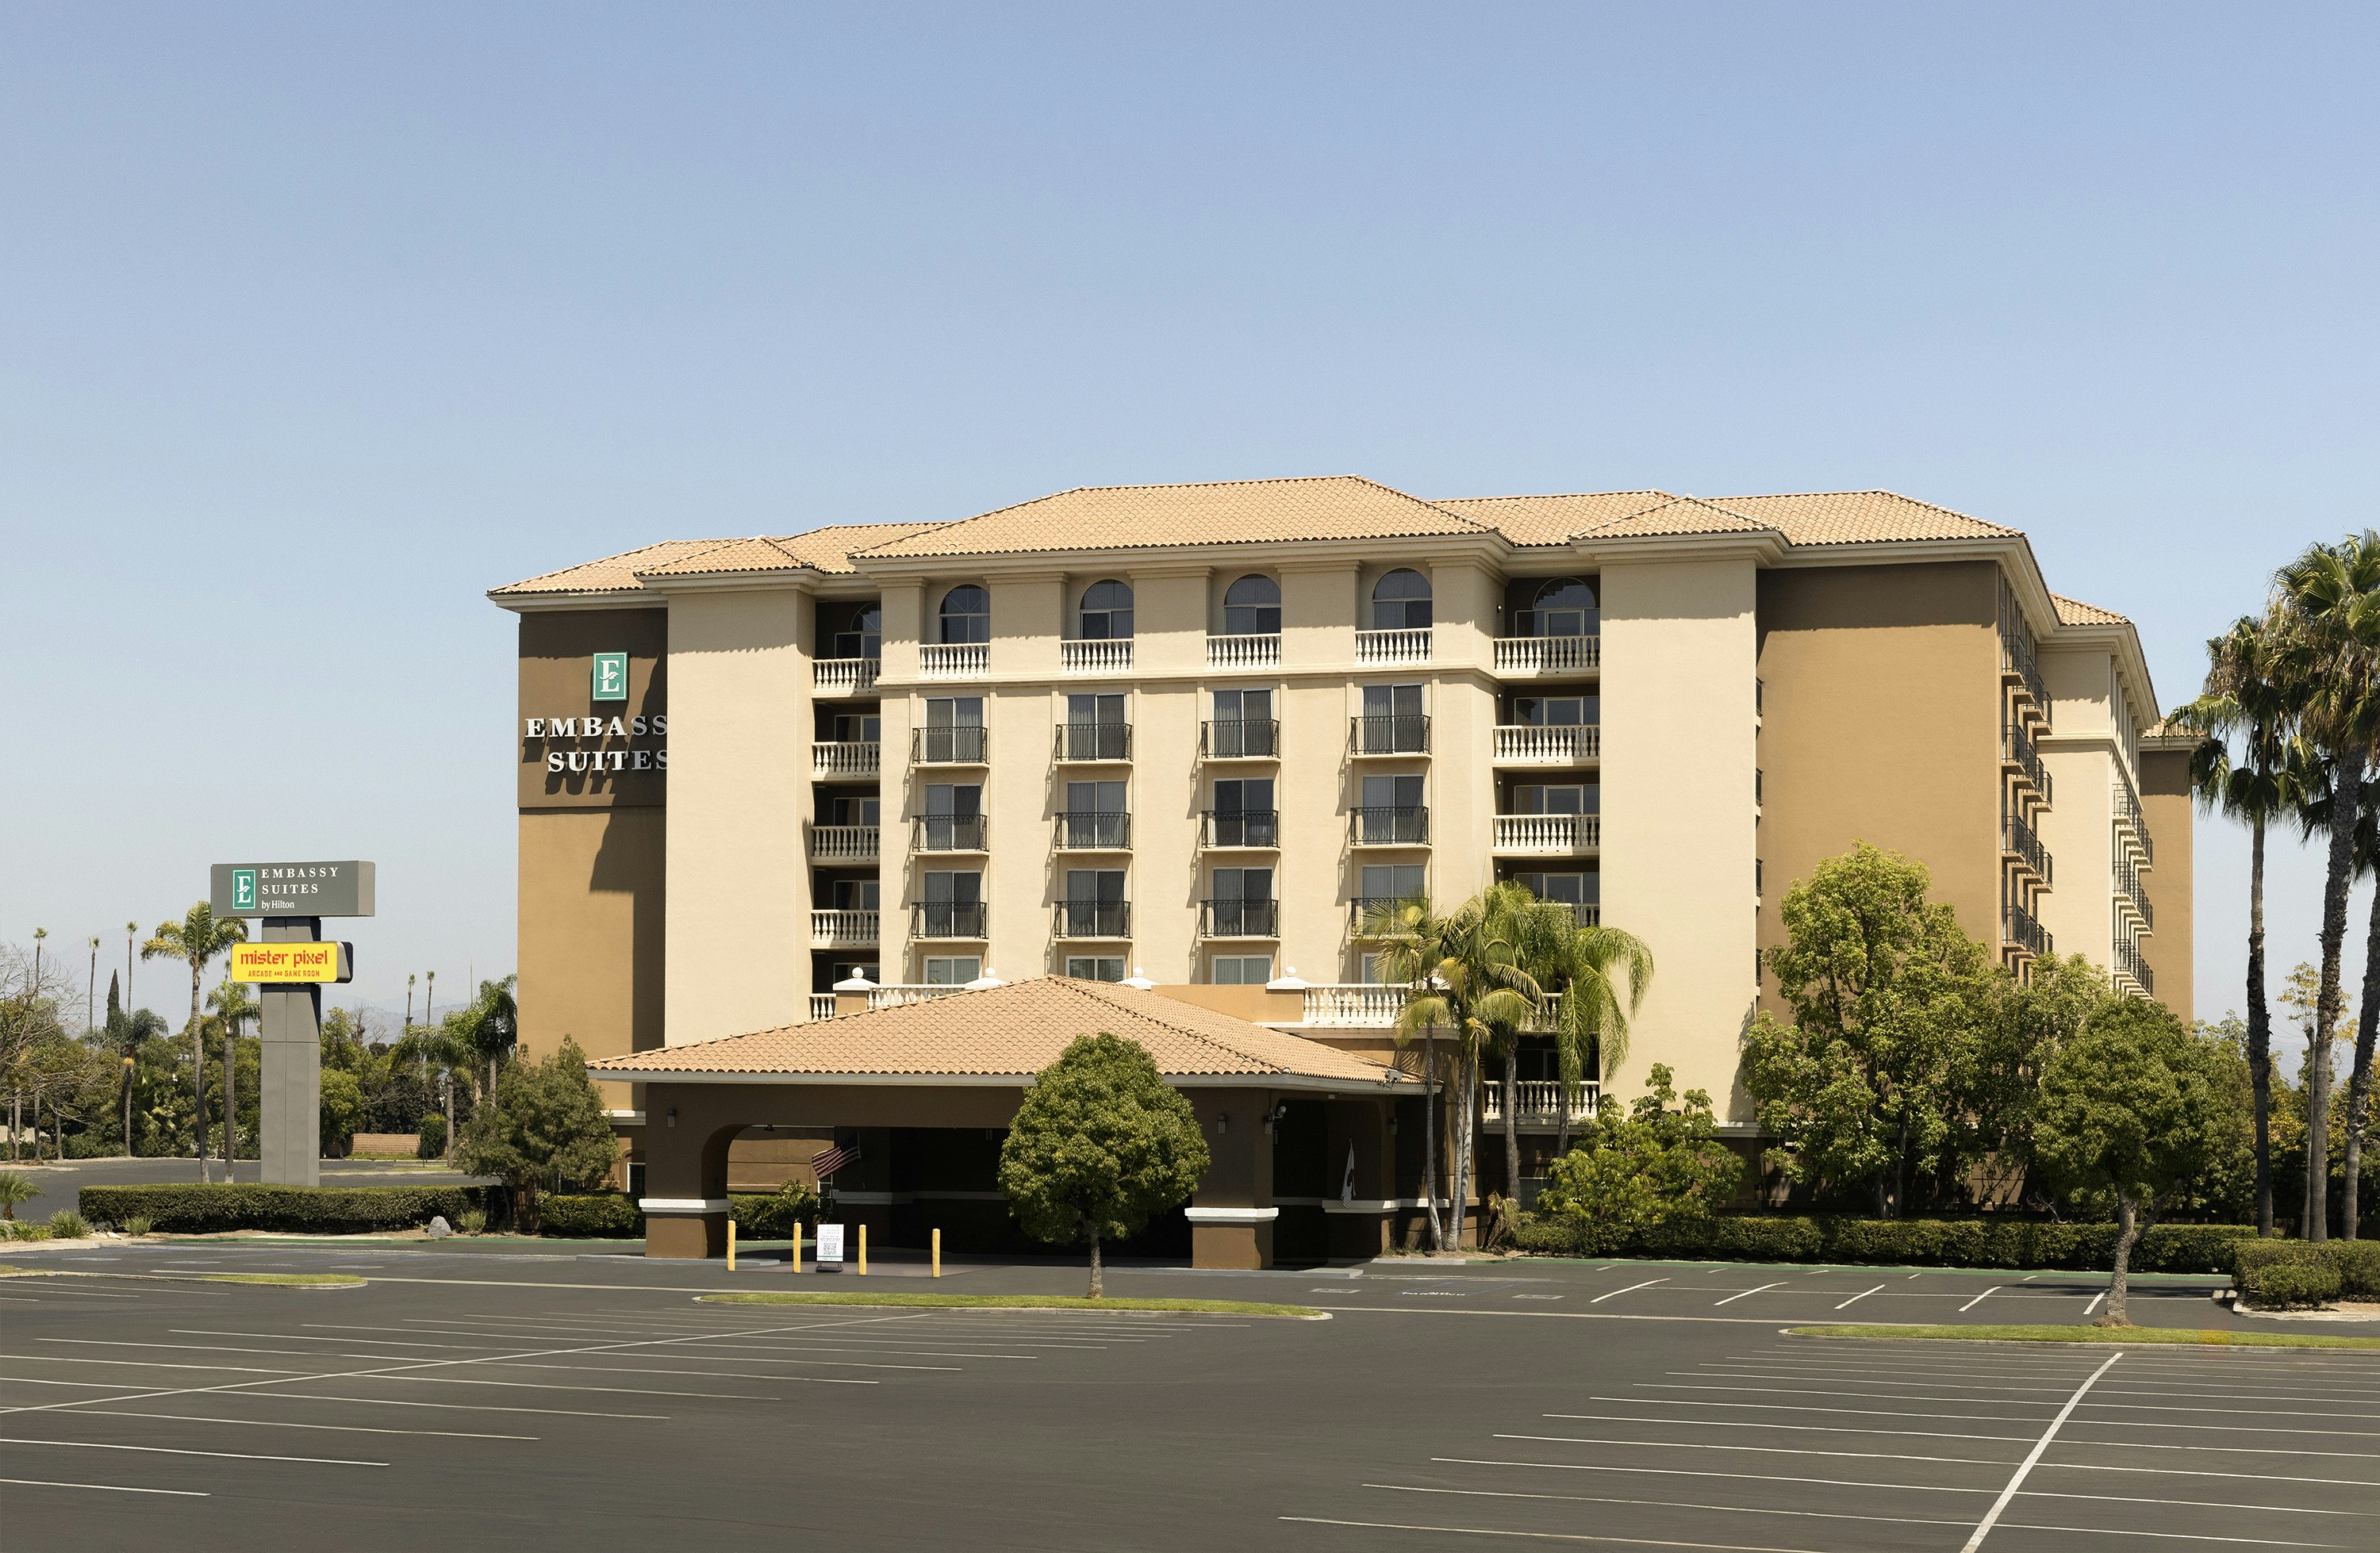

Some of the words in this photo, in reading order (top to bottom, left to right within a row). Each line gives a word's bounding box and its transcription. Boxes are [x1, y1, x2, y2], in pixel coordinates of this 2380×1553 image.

[547, 750, 667, 773] SUITES
[261, 867, 339, 879] EMBASSY
[262, 884, 318, 895] SUITES
[261, 900, 271, 911] by
[271, 899, 295, 909] Hilton
[240, 950, 288, 964] mister
[294, 950, 328, 968] pixel
